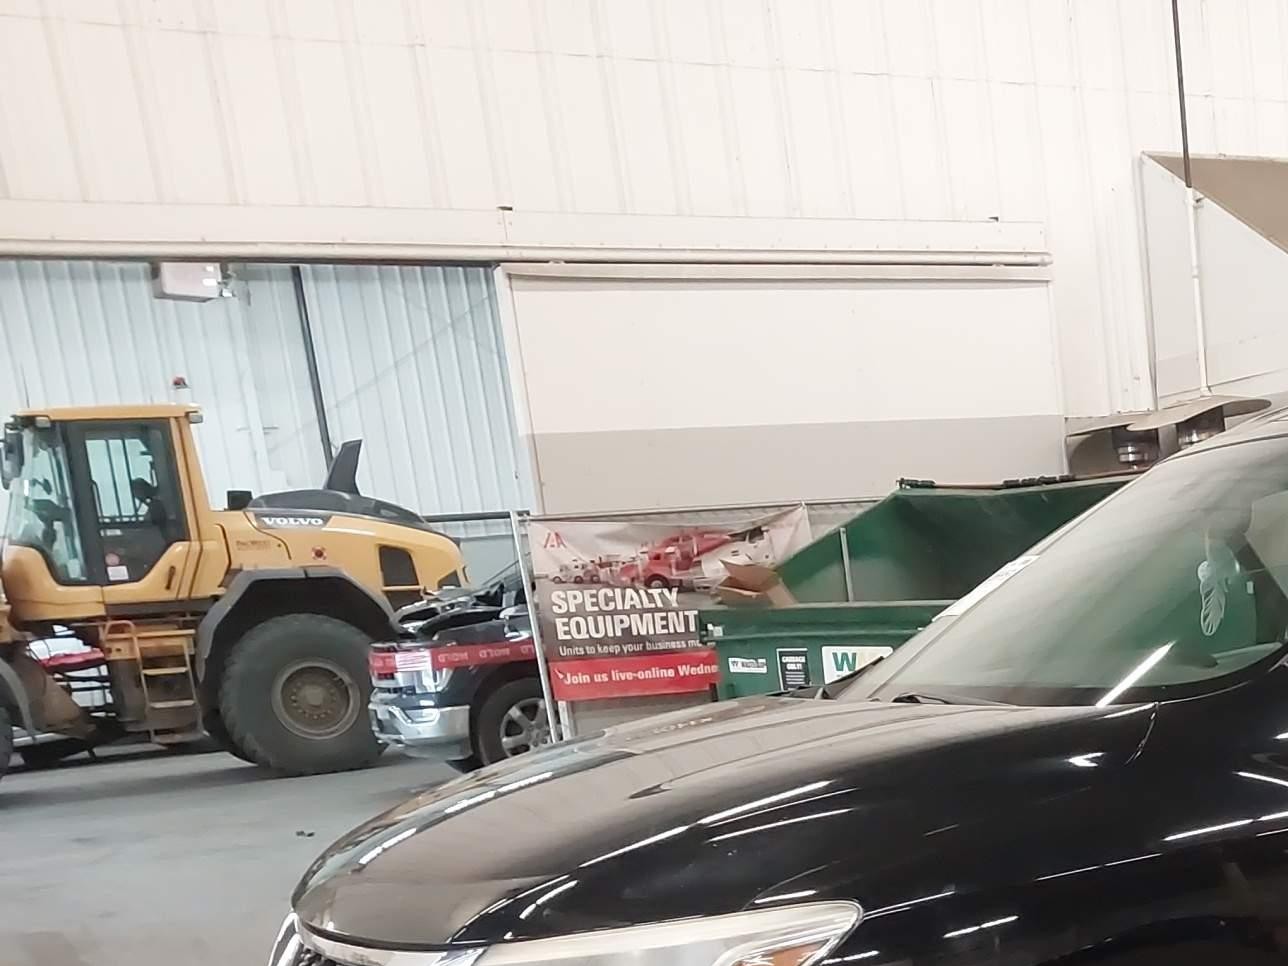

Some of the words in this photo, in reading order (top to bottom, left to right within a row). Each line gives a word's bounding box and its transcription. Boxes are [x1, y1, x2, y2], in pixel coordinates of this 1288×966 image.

[261, 517, 323, 525] VOLVO
[551, 587, 679, 614] SPECIALTY
[555, 610, 698, 640] EQUIPMENT
[559, 645, 585, 656] Units
[585, 645, 596, 654] to
[598, 644, 621, 656] keep
[622, 643, 643, 654] your
[646, 640, 687, 650] business
[563, 671, 590, 685] Join
[594, 671, 609, 682] us
[612, 665, 675, 681] live-online
